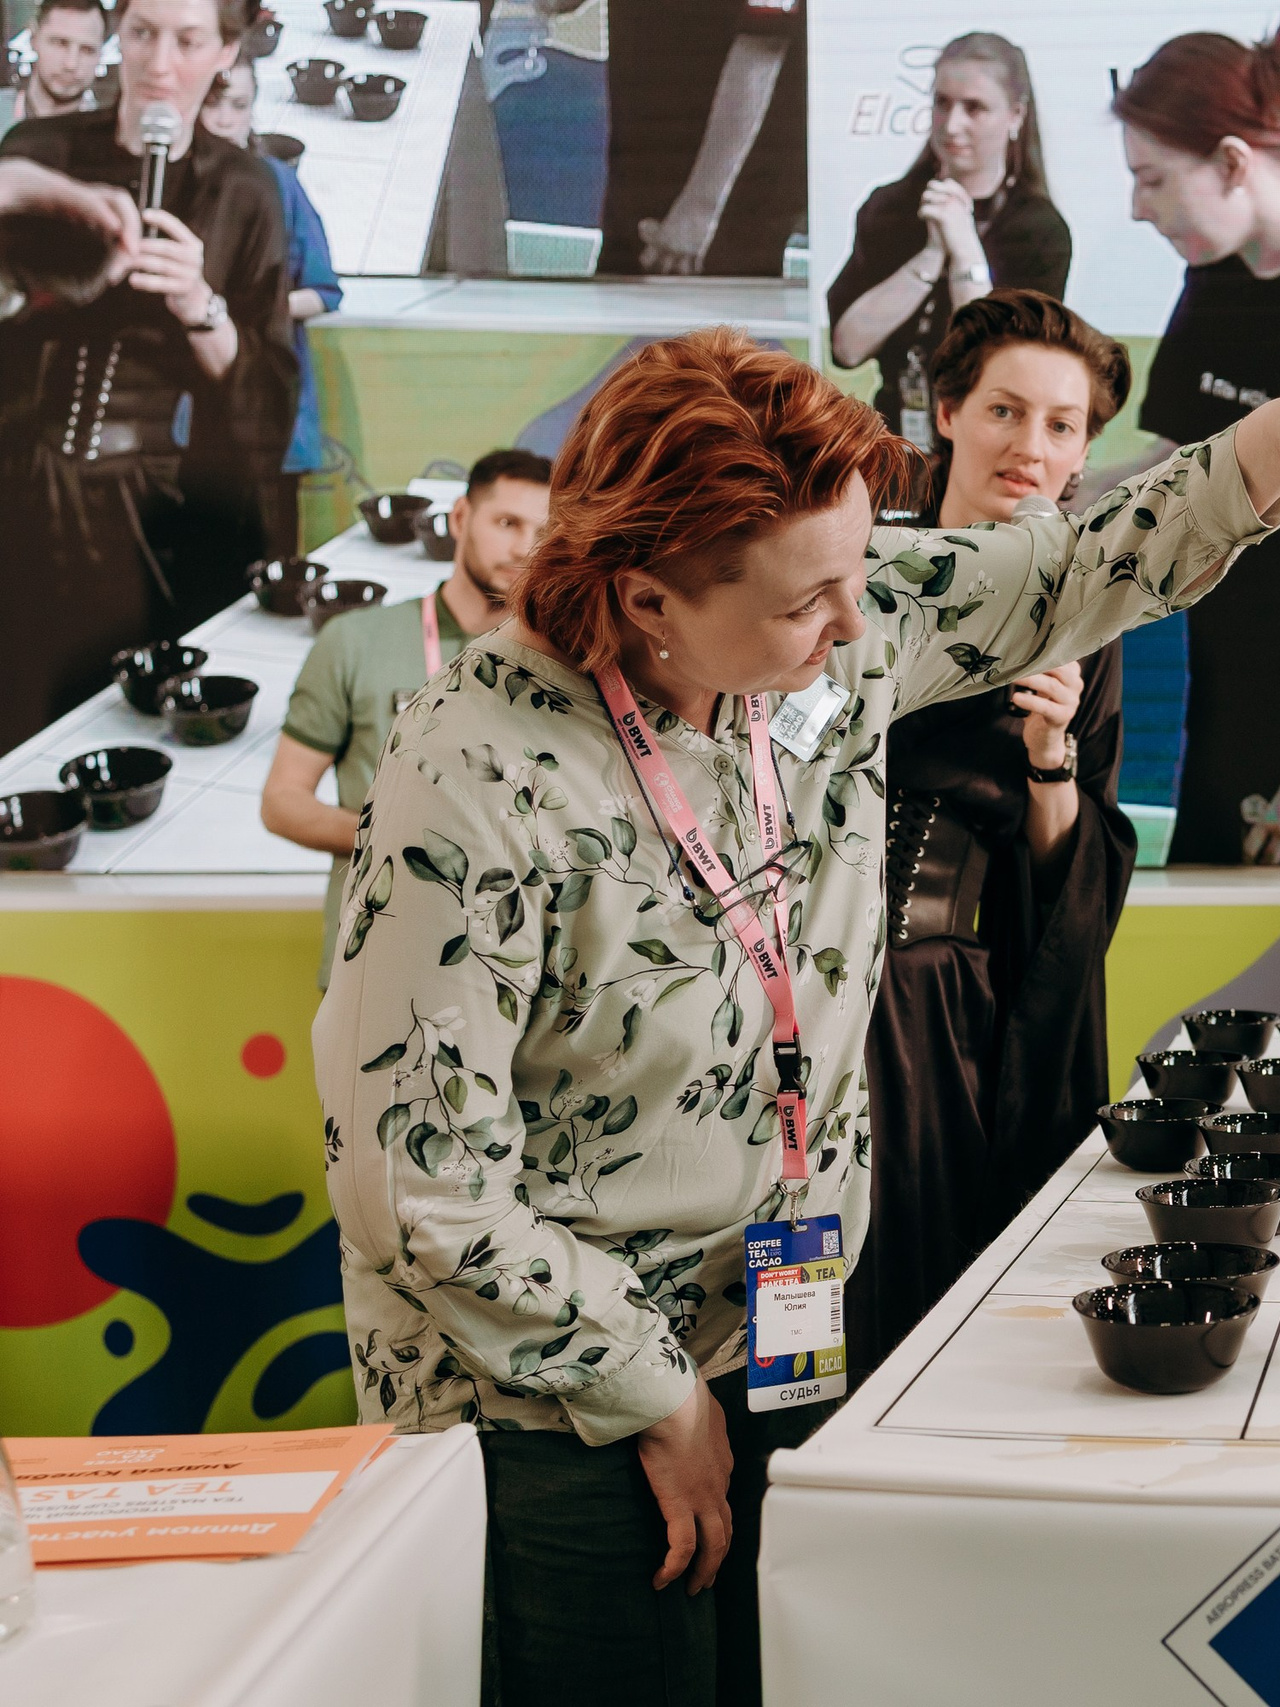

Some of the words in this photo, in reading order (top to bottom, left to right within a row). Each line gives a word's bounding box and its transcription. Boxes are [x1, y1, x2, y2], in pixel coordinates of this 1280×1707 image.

[627, 725, 652, 759] BWT
[763, 803, 775, 837] BWT
[691, 841, 717, 873] BWT
[758, 951, 779, 980] BWT
[785, 1118, 798, 1150] BWT
[747, 1239, 782, 1250] COFFEE
[748, 1249, 768, 1259] TEA
[748, 1257, 782, 1268] CACAO
[760, 1271, 778, 1279] DON'T
[779, 1269, 799, 1277] WORRY
[816, 1267, 836, 1280] TEA
[761, 1279, 784, 1288] MAKE
[785, 1278, 800, 1287] TEA
[773, 1290, 816, 1302] Малышева
[784, 1303, 807, 1312] Юлия
[819, 1356, 842, 1374] CACAO
[780, 1384, 820, 1401] СУДЬЯ
[22, 1487, 122, 1503] TAS
[146, 1481, 234, 1496] TEA
[126, 1498, 207, 1507] MASTERS
[146, 1522, 278, 1537] Диплом
[1205, 1567, 1265, 1625] AEROPRESS
